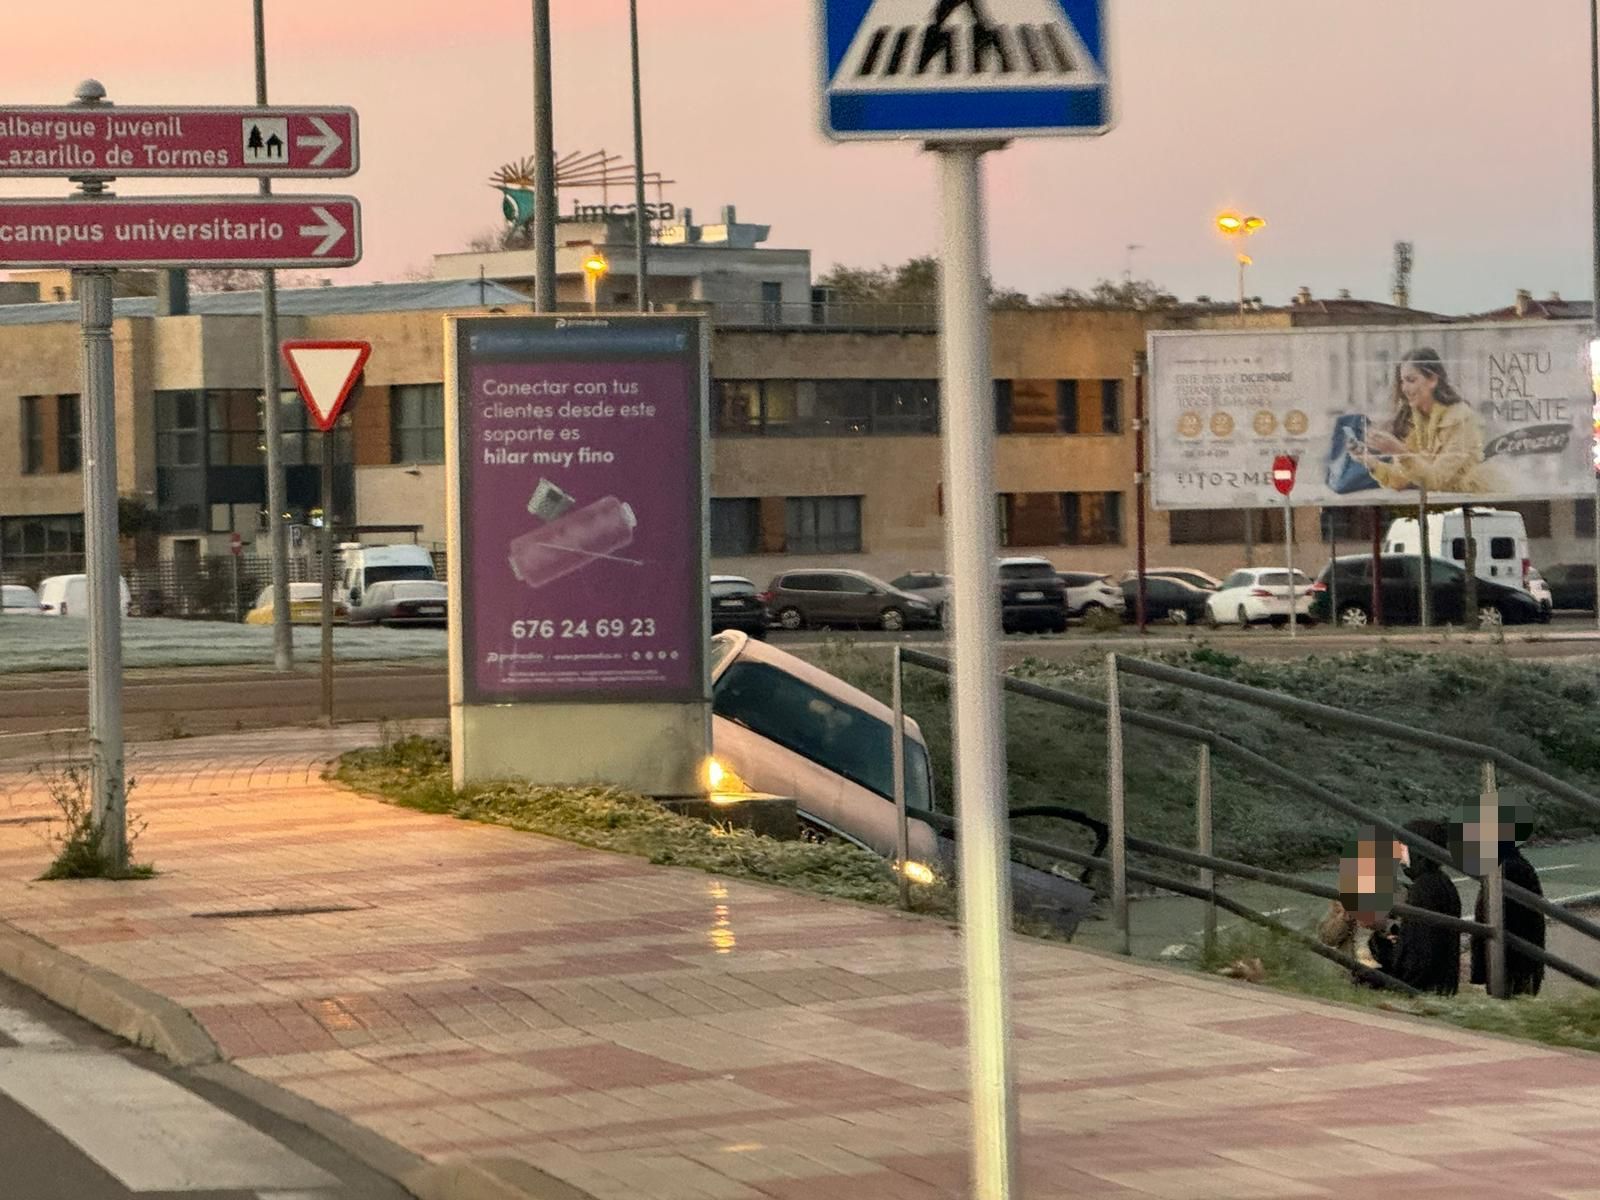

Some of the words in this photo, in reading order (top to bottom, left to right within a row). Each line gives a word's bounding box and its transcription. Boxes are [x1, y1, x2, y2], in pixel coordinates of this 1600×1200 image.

[0, 117, 96, 139] albergue
[106, 116, 182, 138] juvenil
[106, 145, 134, 164] de
[143, 145, 229, 165] Tormes
[0, 223, 104, 245] campus
[116, 218, 284, 242] universitario
[1489, 352, 1551, 375] NATU
[482, 379, 569, 396] Conectar
[574, 381, 607, 395] con
[612, 379, 639, 395] tus
[1490, 376, 1534, 398] RAL
[484, 401, 553, 419] clientes
[559, 401, 614, 417] desde
[620, 403, 656, 417] este
[1491, 398, 1569, 421] MENTE
[484, 428, 554, 445] soporte
[560, 428, 580, 441] es
[484, 448, 529, 464] hilar
[533, 450, 573, 468] muy
[578, 447, 615, 463] fino
[511, 620, 555, 639] 676
[560, 619, 590, 638] 24
[595, 619, 624, 637] 69
[630, 618, 657, 637] 23
